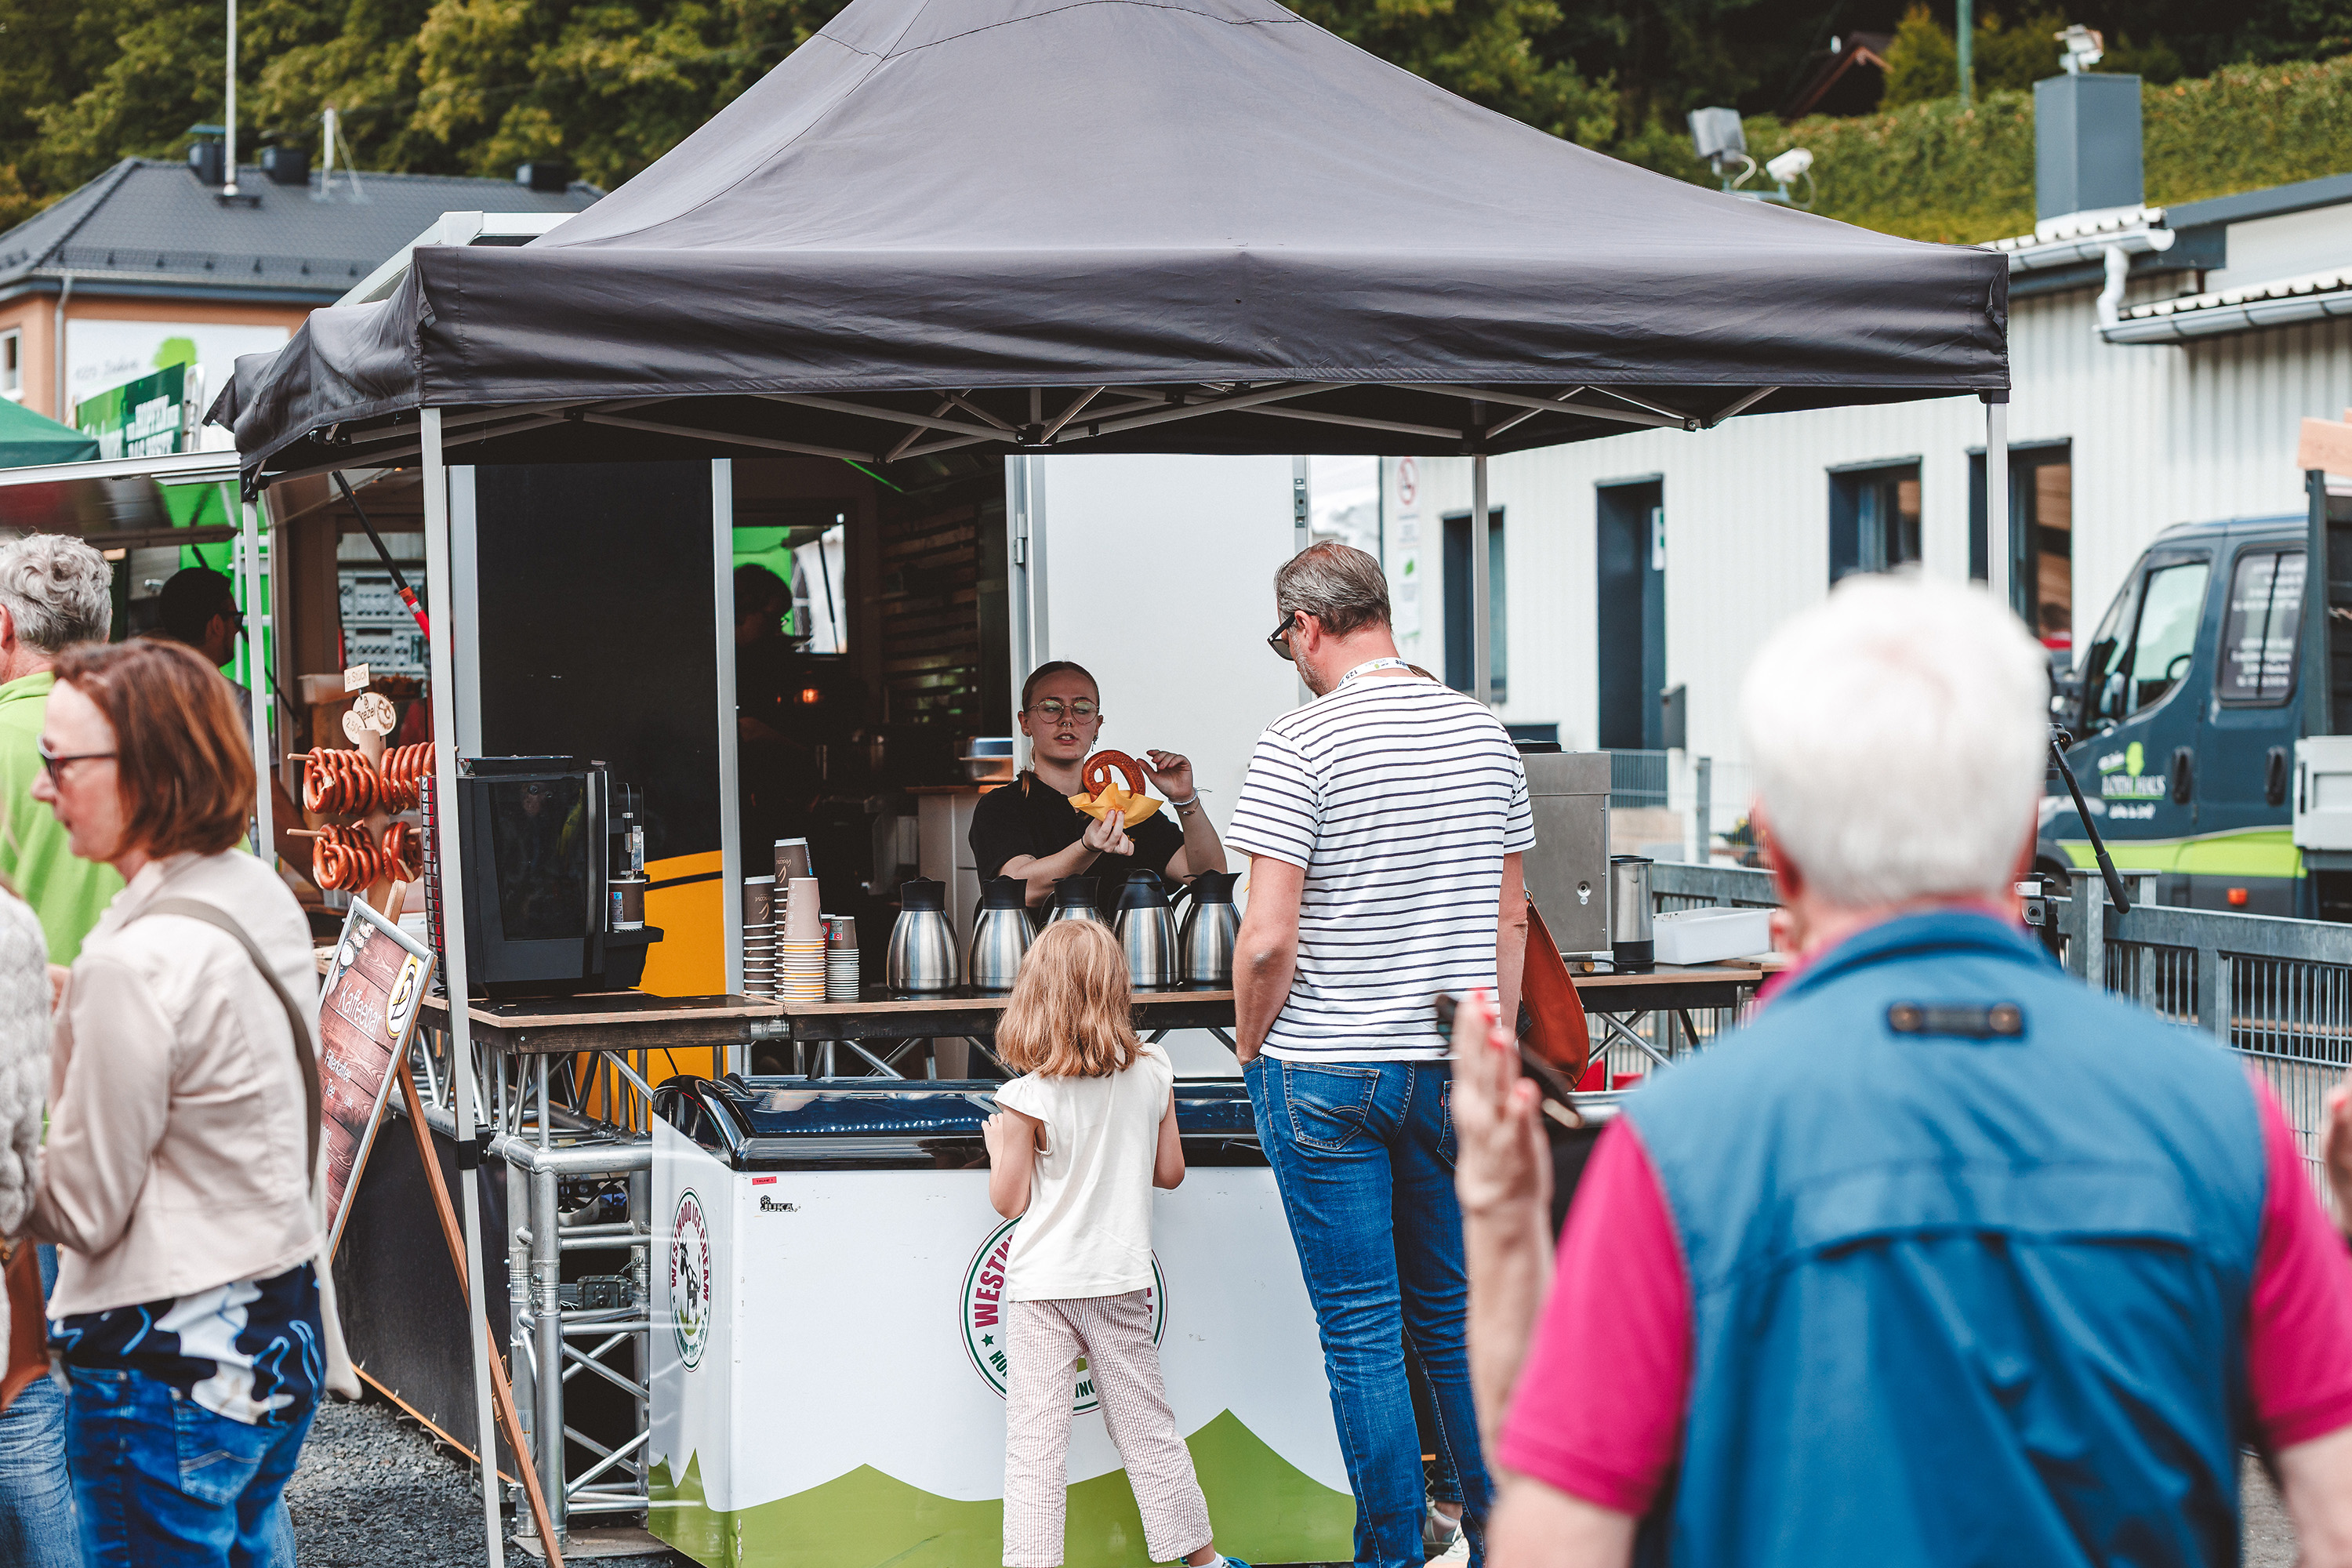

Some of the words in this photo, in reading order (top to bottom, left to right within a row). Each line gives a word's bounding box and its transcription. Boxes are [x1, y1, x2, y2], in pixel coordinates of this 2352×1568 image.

[1345, 670, 1358, 680] 125
[337, 980, 383, 1035] Kaffeebar
[324, 1048, 352, 1083] Filterkaffee
[325, 1078, 336, 1099] Tee
[760, 1203, 793, 1212] JUKA
[672, 1201, 691, 1287] WESTWOOD
[692, 1203, 701, 1235] ICE
[700, 1228, 710, 1301] CREAM
